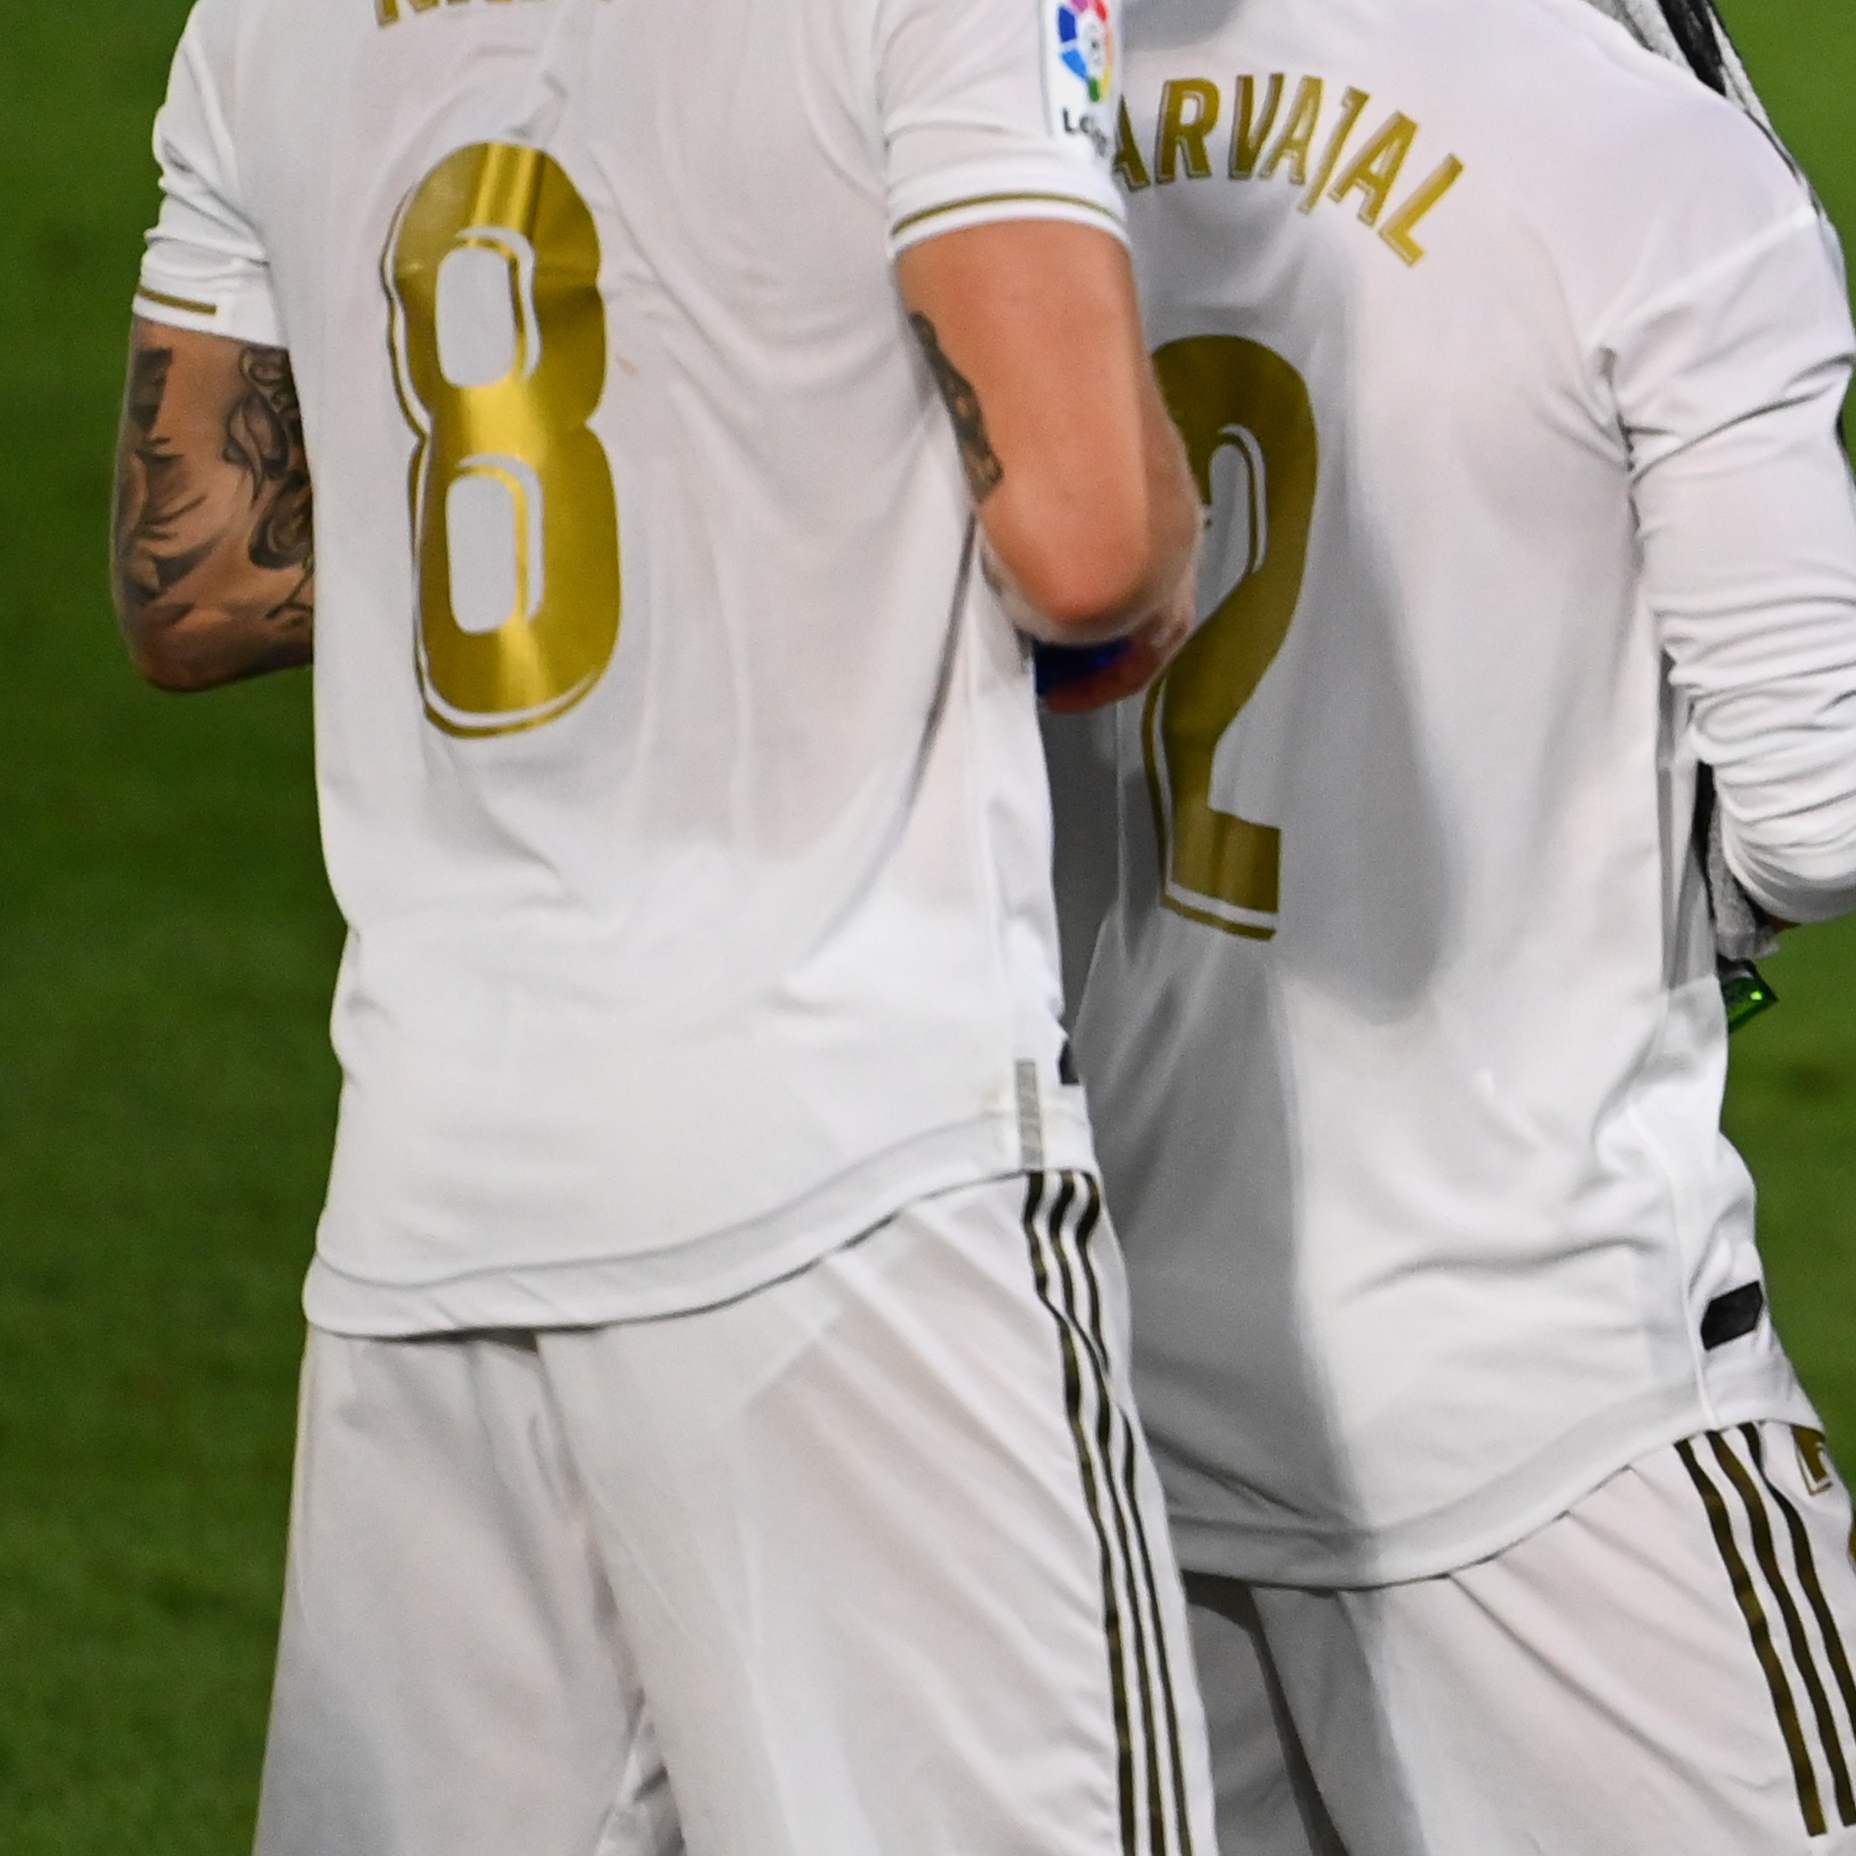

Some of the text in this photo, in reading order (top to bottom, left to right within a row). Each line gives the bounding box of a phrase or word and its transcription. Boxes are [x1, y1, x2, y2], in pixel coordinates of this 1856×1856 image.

[382, 140, 624, 740] 8
[1113, 72, 1467, 267] ARVAJAL
[1142, 334, 1320, 942] 2
